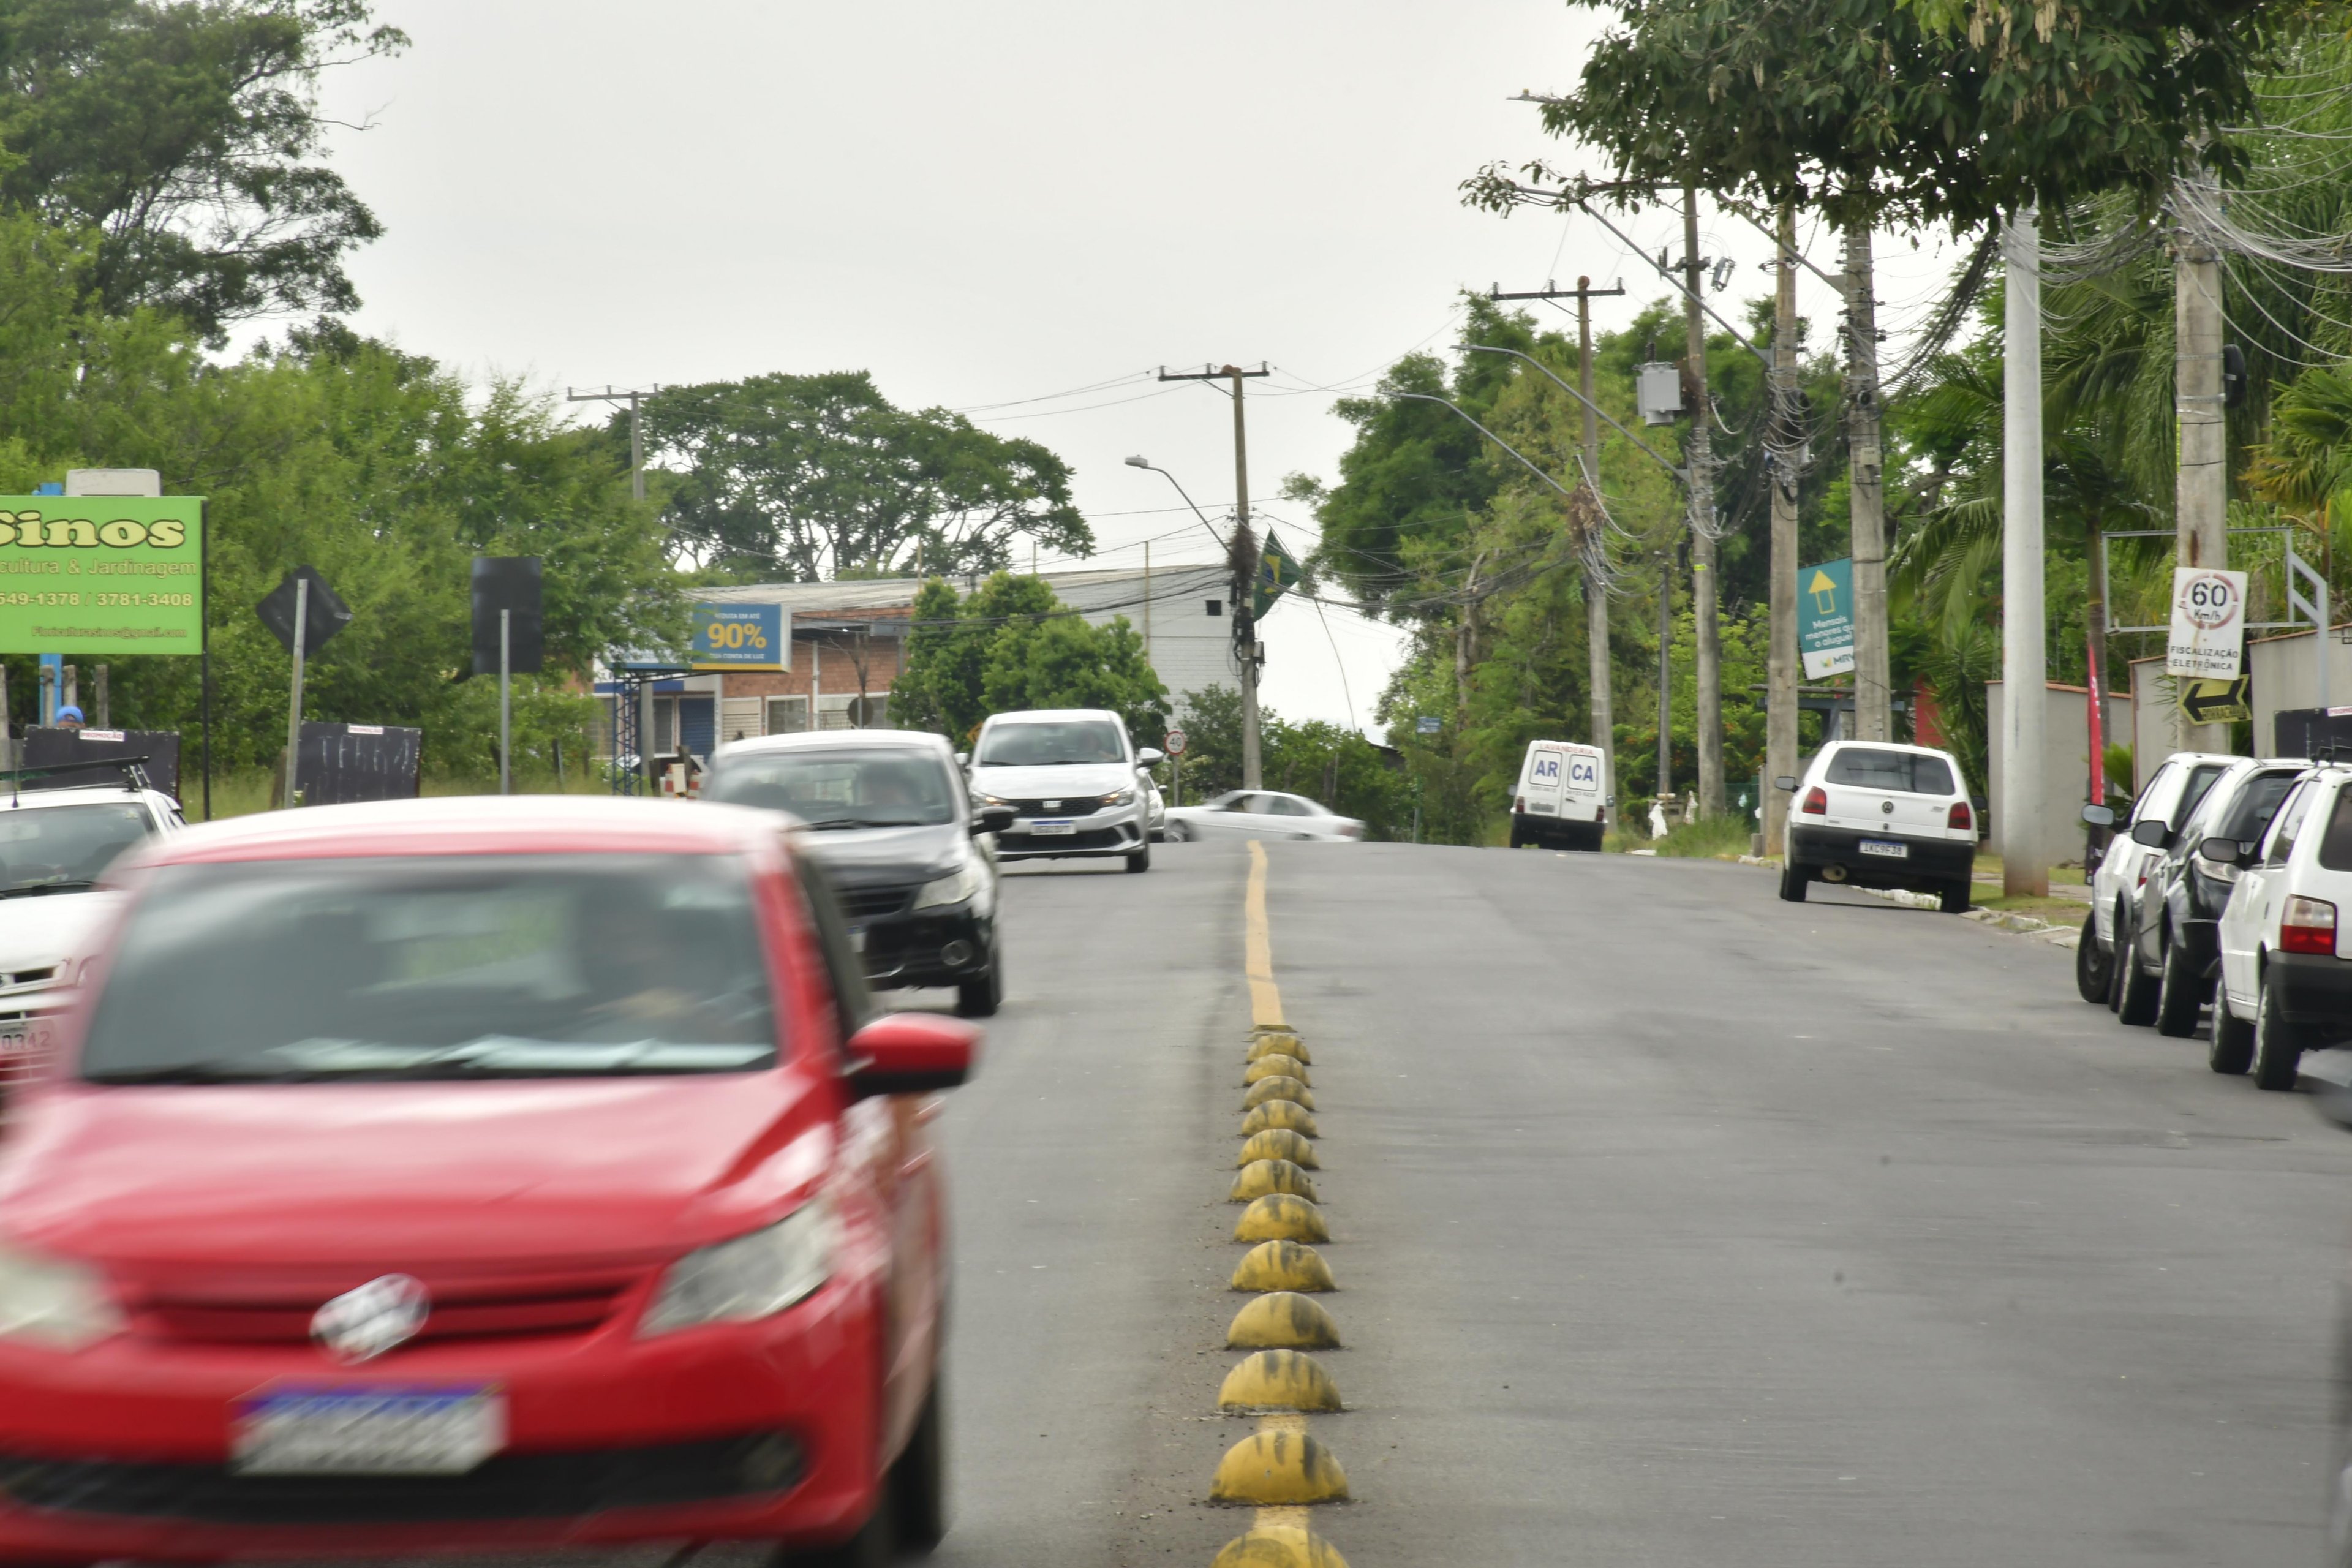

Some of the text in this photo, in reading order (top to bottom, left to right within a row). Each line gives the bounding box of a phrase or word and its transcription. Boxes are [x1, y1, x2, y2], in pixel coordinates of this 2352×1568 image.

[67, 558, 81, 575] &
[88, 558, 197, 578] Jardinagem
[85, 592, 91, 606] /
[96, 593, 193, 607] 3781-3408
[2192, 582, 2227, 607] 60
[2193, 609, 2221, 621] Km/h
[1812, 615, 1847, 630] Mensais
[707, 622, 767, 649] 90%
[1804, 627, 1842, 641] menores
[1822, 633, 1853, 646] aluguel
[2170, 646, 2239, 659] FISCALIZAÇÃO
[2173, 658, 2234, 671] ELETRÔNICA
[1169, 737, 1181, 746] 40
[1539, 743, 1594, 755] LAVANDERIA
[1534, 760, 1594, 782] AR CA
